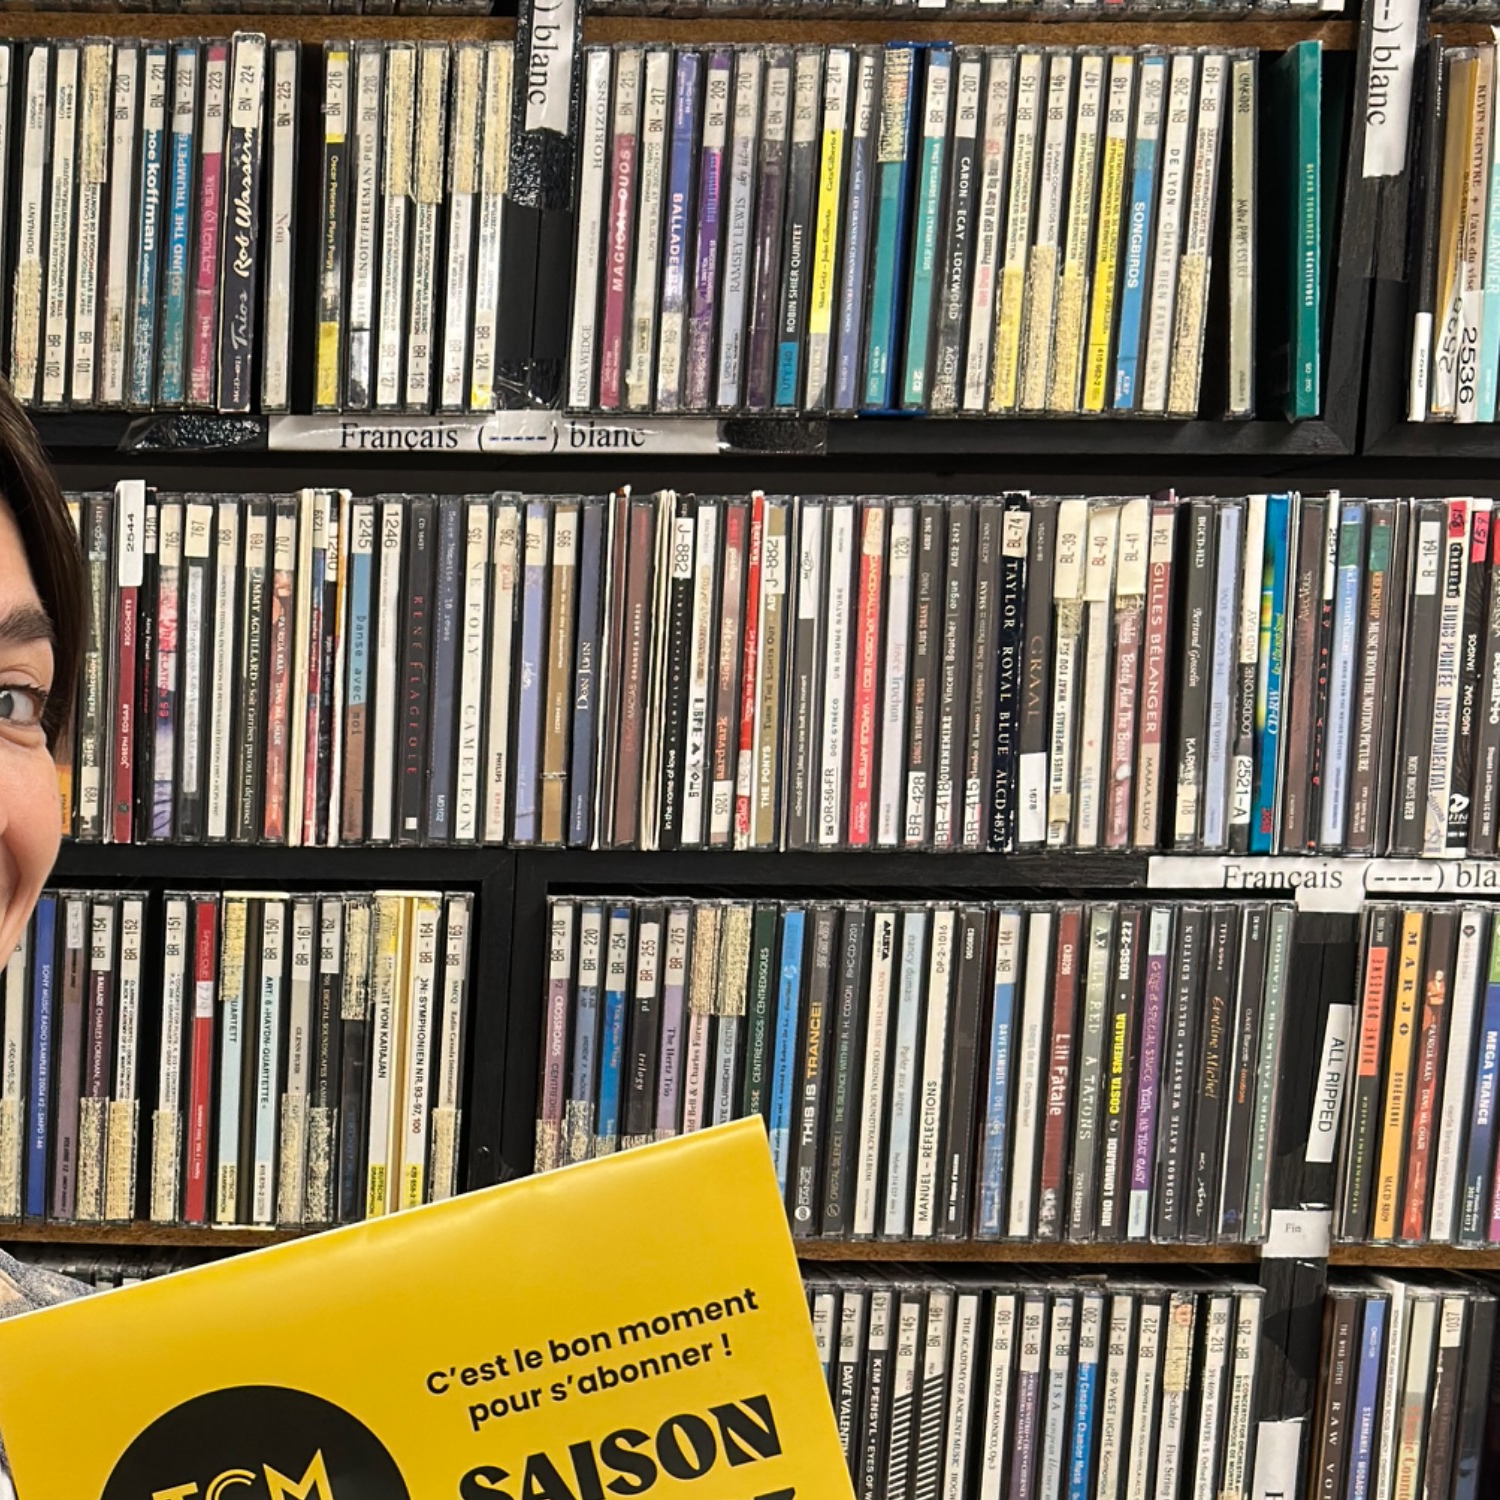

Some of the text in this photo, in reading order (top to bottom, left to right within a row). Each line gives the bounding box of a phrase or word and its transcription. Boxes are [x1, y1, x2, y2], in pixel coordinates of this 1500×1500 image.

[527, 24, 558, 105] blanc
[1366, 46, 1398, 126] blanc
[592, 80, 606, 169] HORIZONS
[142, 162, 160, 251] koffman
[957, 157, 969, 198] CARON
[954, 210, 966, 239] ECAY
[1126, 202, 1144, 288] SONGBIRDS
[1457, 326, 1476, 404] 2536
[340, 423, 459, 452] Français
[569, 422, 646, 448] blanc
[356, 510, 372, 548] 1245
[383, 510, 398, 548] 1246
[674, 524, 690, 573] J-882
[247, 571, 262, 682] JIMMY AGUILLARD
[1003, 562, 1016, 629] TAYLOR
[1150, 562, 1164, 626] GILLES
[1363, 649, 1377, 677] FROM
[1364, 622, 1379, 648] MUSIC
[999, 646, 1012, 703] ROYAL
[1145, 634, 1160, 733] BÉLANGER
[995, 711, 1009, 756] BLUE
[458, 704, 476, 833] CAMELEON
[1232, 760, 1252, 818] 2521-A
[1456, 863, 1500, 888] bla
[376, 1031, 387, 1079] KARAJAN
[1047, 1034, 1069, 1116] Lili Fatale
[1317, 1036, 1345, 1132] ALL RIPPED
[1476, 1031, 1497, 1125] MEGA TRANCE
[801, 1107, 815, 1145] THIS
[425, 1289, 760, 1397] C'est le bon moment
[468, 1336, 732, 1432] pour s'abonner !
[866, 1358, 883, 1436] KIM PENSYL
